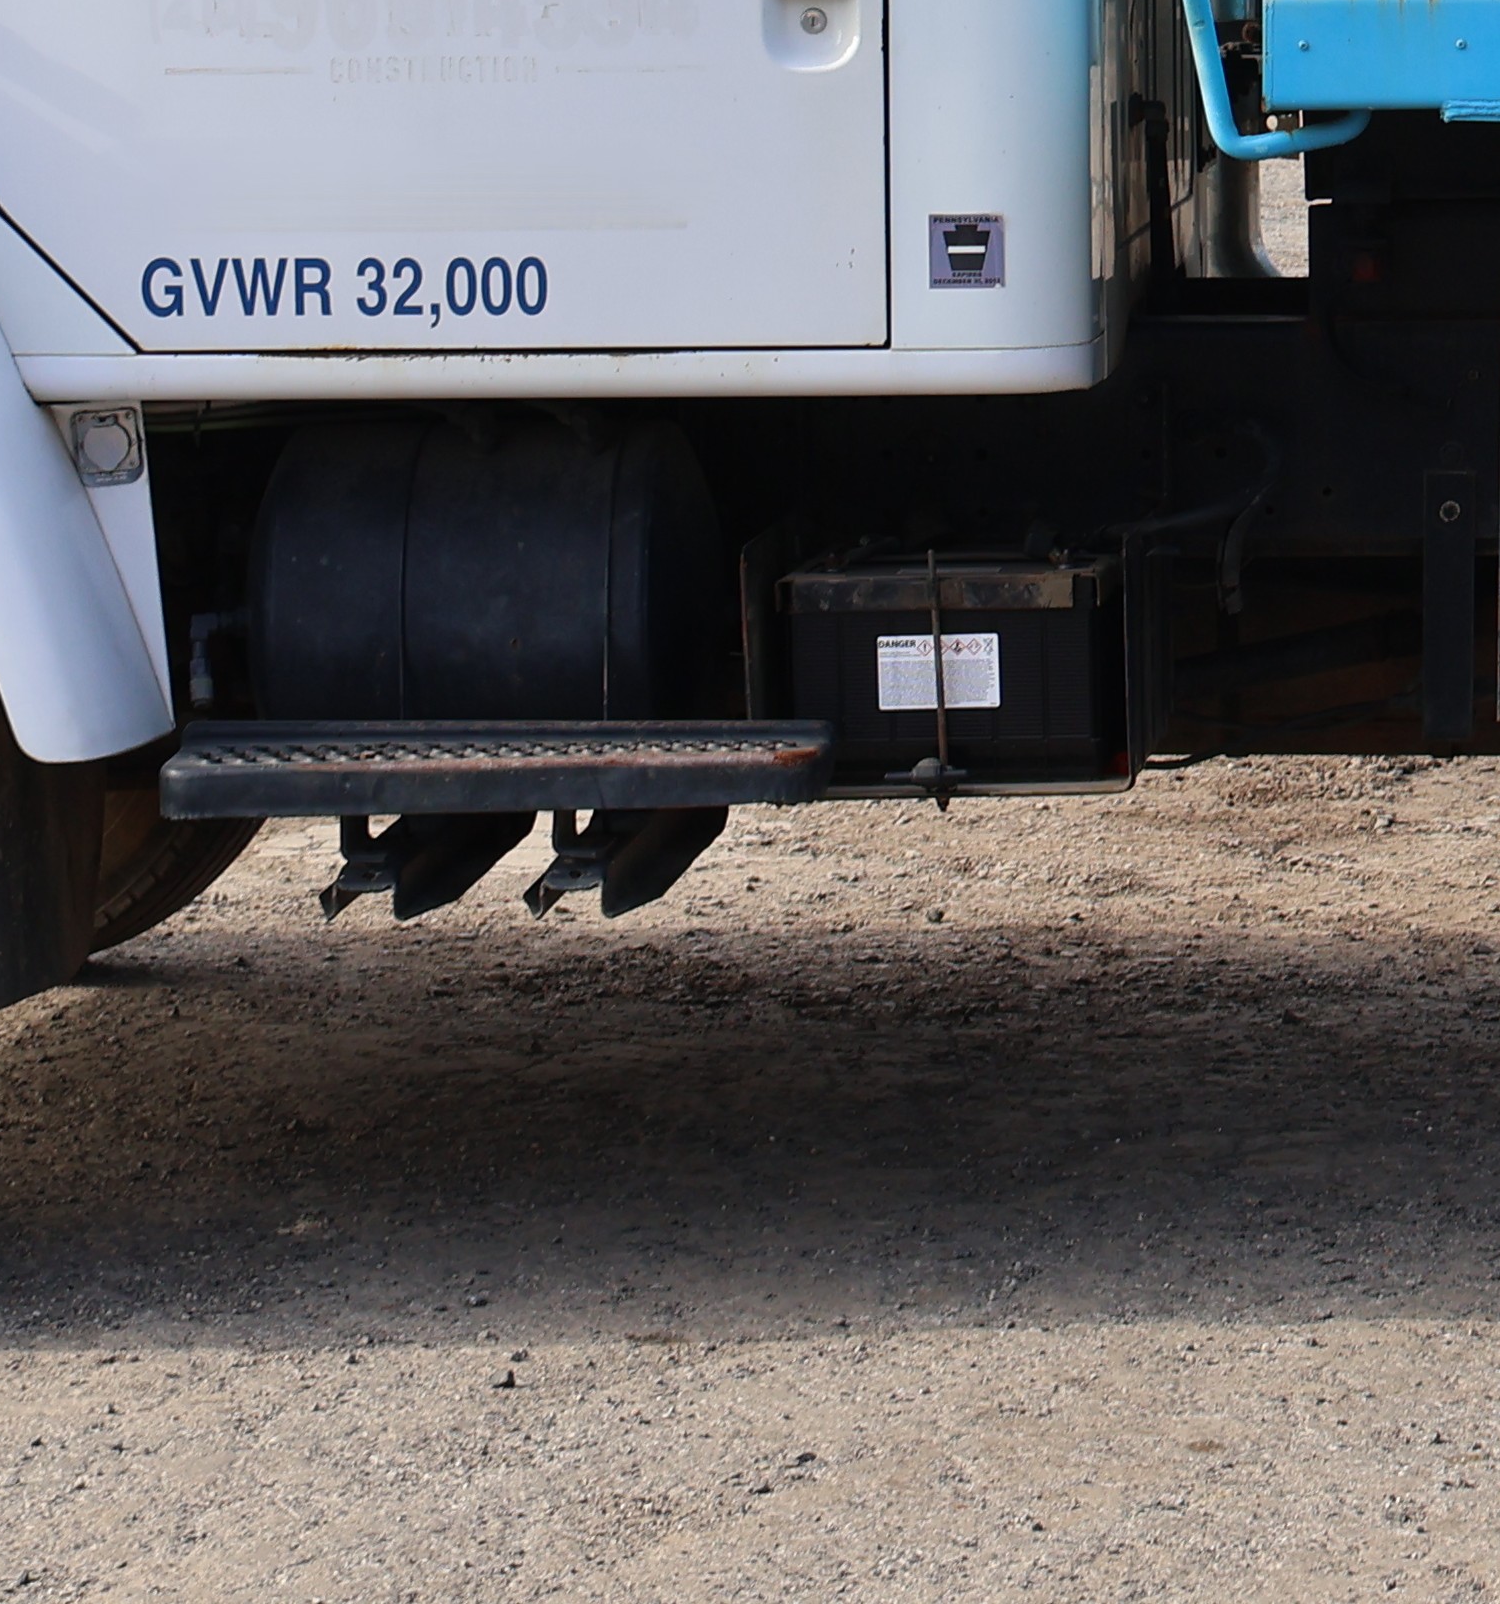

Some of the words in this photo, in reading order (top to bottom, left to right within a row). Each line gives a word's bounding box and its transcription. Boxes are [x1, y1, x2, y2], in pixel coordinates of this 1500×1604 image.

[141, 257, 333, 318] GVWR
[355, 256, 547, 330] 32,000
[878, 639, 917, 649] DANGER
